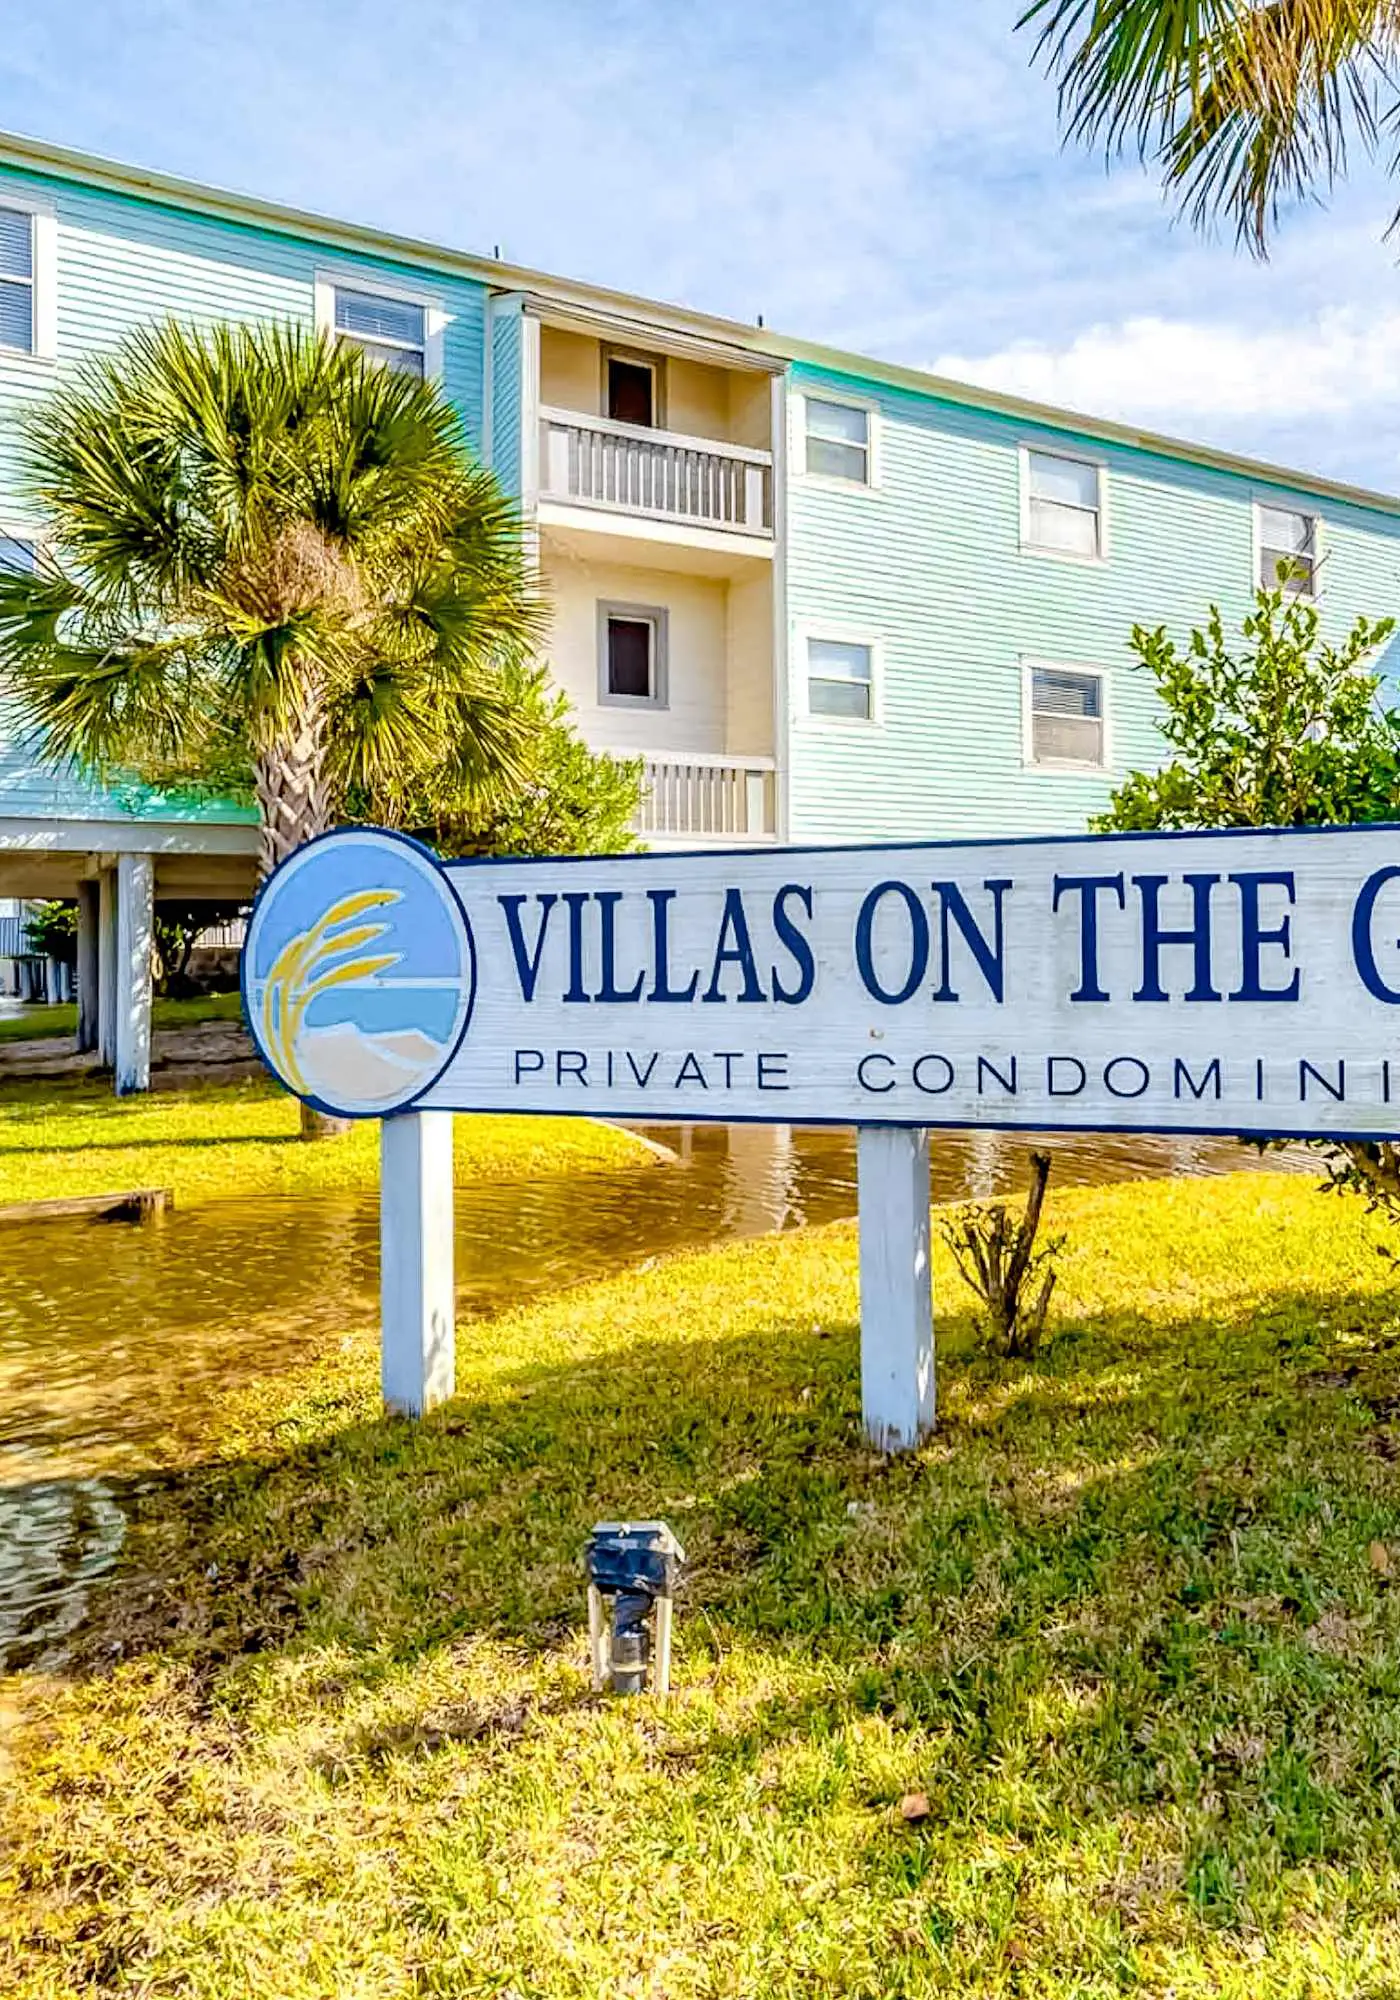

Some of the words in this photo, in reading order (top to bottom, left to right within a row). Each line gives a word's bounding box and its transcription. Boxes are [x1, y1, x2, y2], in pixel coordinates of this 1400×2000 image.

[497, 884, 815, 1005] VILLAS
[855, 879, 1013, 1005] ON
[1052, 872, 1301, 1002] THE
[515, 1049, 790, 1091] PRIVATE
[857, 1053, 1390, 1104] CONDOMINI
